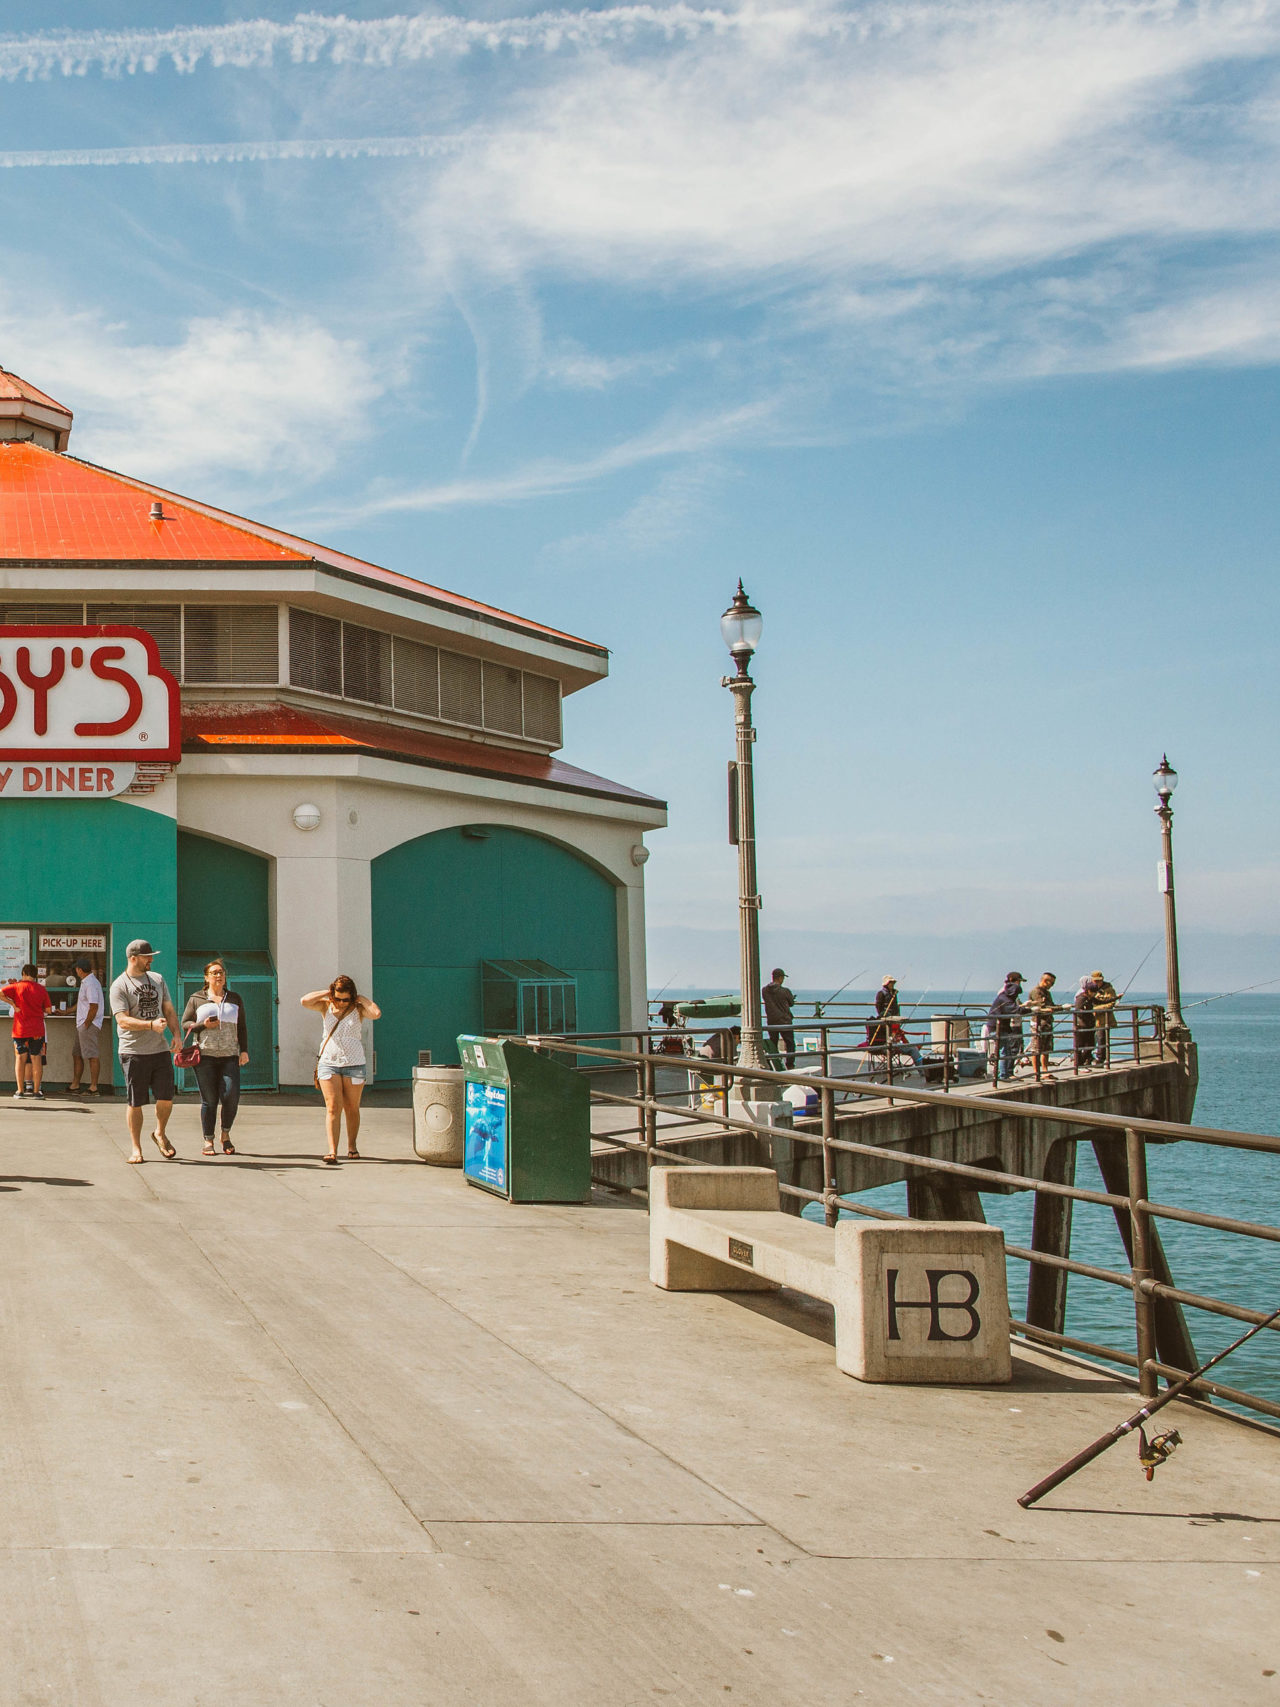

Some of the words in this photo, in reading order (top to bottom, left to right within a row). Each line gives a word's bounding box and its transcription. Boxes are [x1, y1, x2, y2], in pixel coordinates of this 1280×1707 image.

[23, 767, 115, 792] DINER
[42, 938, 78, 948] PICK-UP
[81, 938, 103, 948] HERE
[886, 1268, 981, 1341] HB
